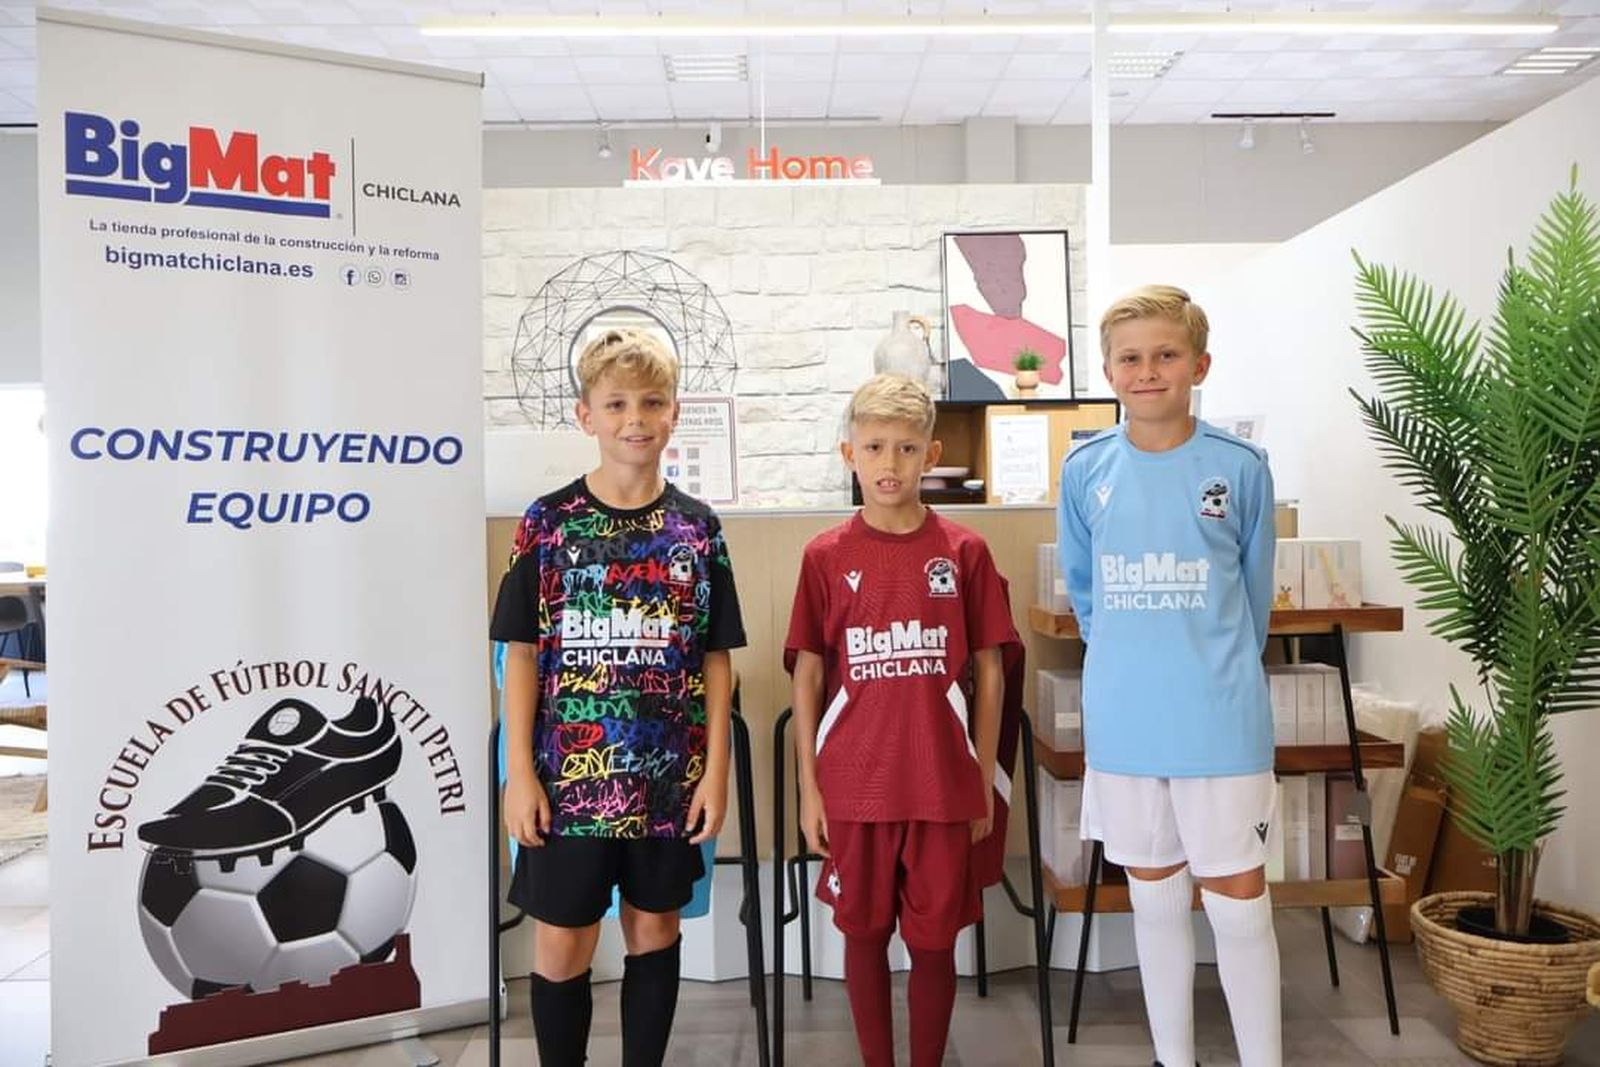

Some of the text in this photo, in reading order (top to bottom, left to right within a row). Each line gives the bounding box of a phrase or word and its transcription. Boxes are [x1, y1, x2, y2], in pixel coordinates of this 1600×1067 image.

[65, 112, 461, 208] BigMat CHICLANA
[628, 147, 874, 180] Kave Home
[89, 219, 440, 261] La tienda profesional de la construcción y la reforma
[105, 246, 314, 278] bigmatchiclana.es
[70, 427, 463, 466] CONSTRUYENDO
[187, 491, 371, 530] EQUIPO
[1100, 553, 1211, 591] BigMat
[1103, 593, 1206, 610] CHICLANA
[562, 607, 673, 646] BigMat
[846, 619, 948, 659] BigMat
[562, 648, 666, 667] CHICLANA
[849, 659, 947, 681] CHICLANA
[88, 720, 173, 852] ESCUELA
[165, 685, 211, 725] DE
[210, 660, 329, 702] FÚTBOL
[337, 662, 431, 733] SANCTI
[419, 724, 466, 816] PETRI
